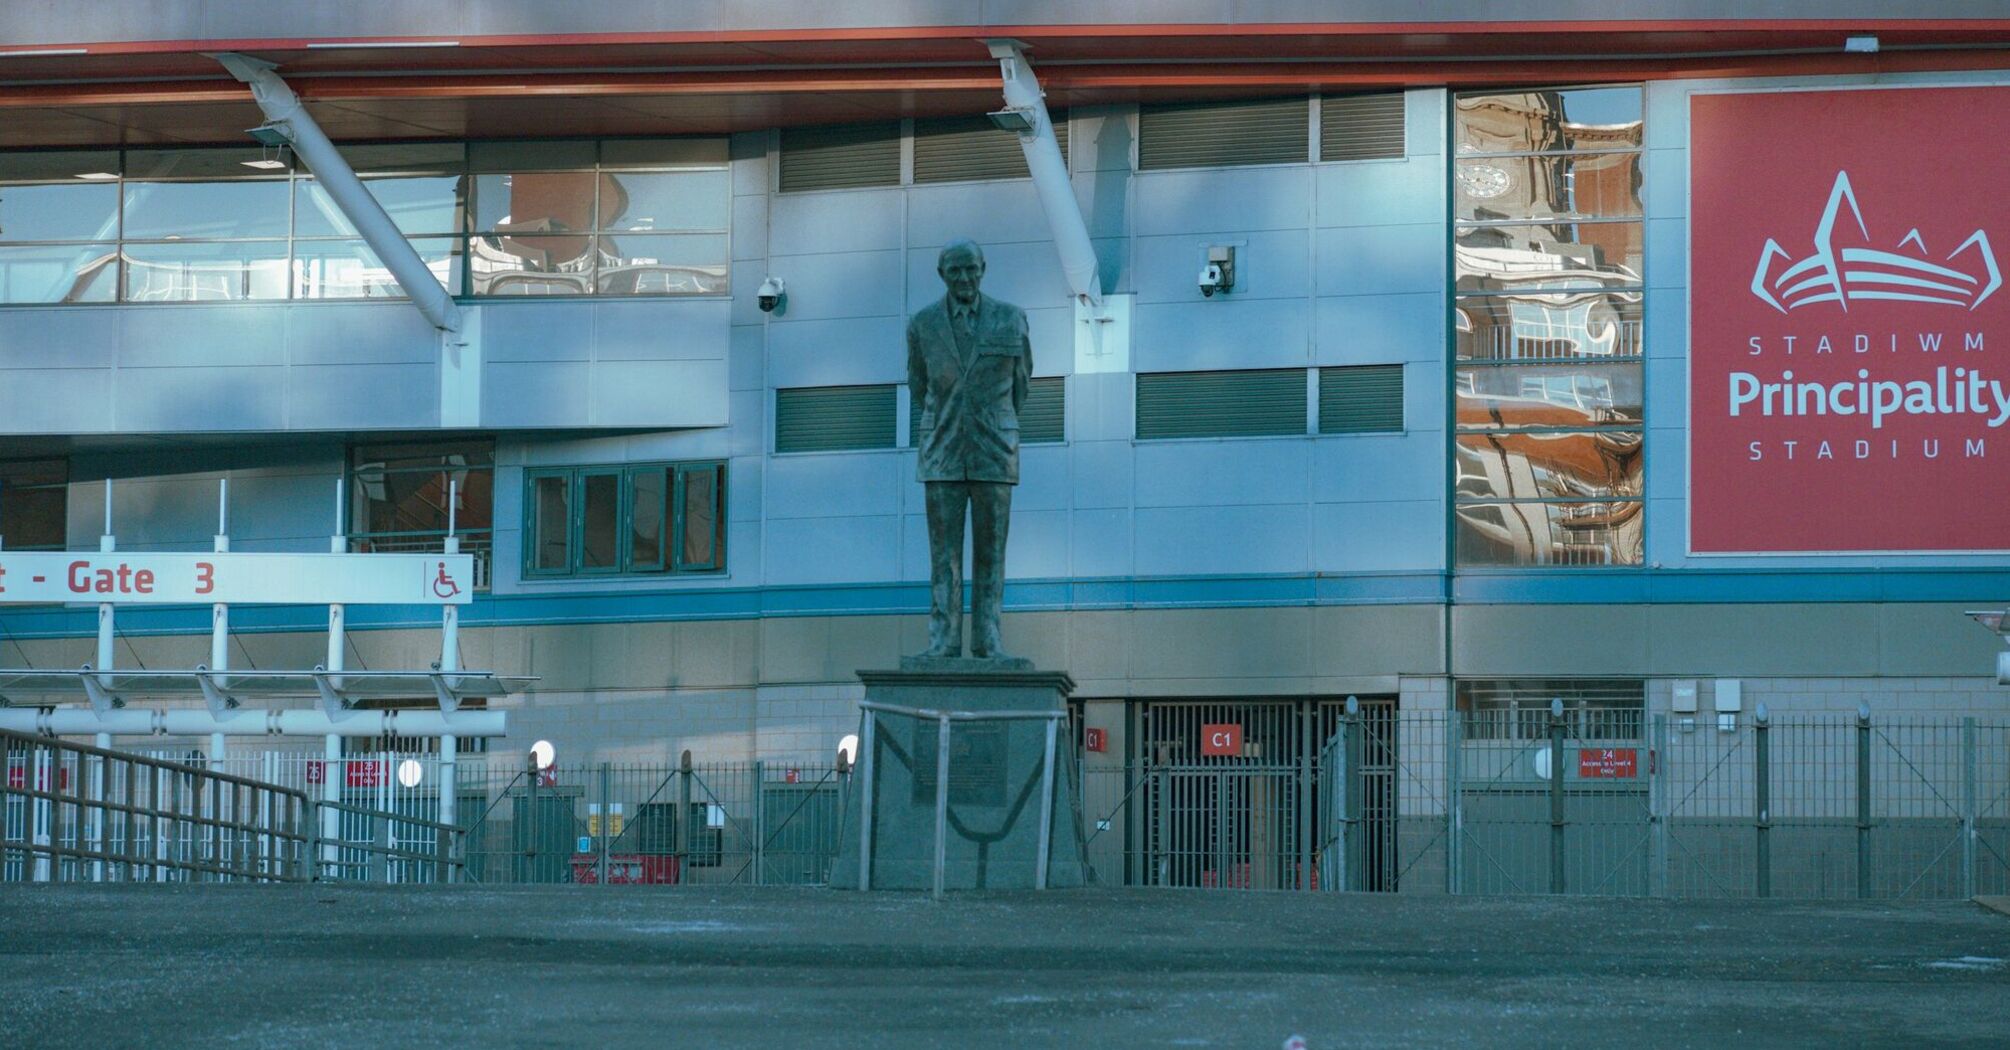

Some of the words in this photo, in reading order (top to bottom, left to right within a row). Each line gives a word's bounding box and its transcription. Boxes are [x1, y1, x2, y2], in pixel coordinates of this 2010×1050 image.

[1749, 332, 1984, 355] STADIWM
[1729, 365, 2010, 429] Principality
[1749, 438, 1984, 461] STADIUM
[68, 561, 154, 593] Gate
[195, 562, 214, 594] 3
[1087, 732, 1097, 748] C1
[1212, 733, 1231, 747] C1
[1602, 750, 1613, 760] 24
